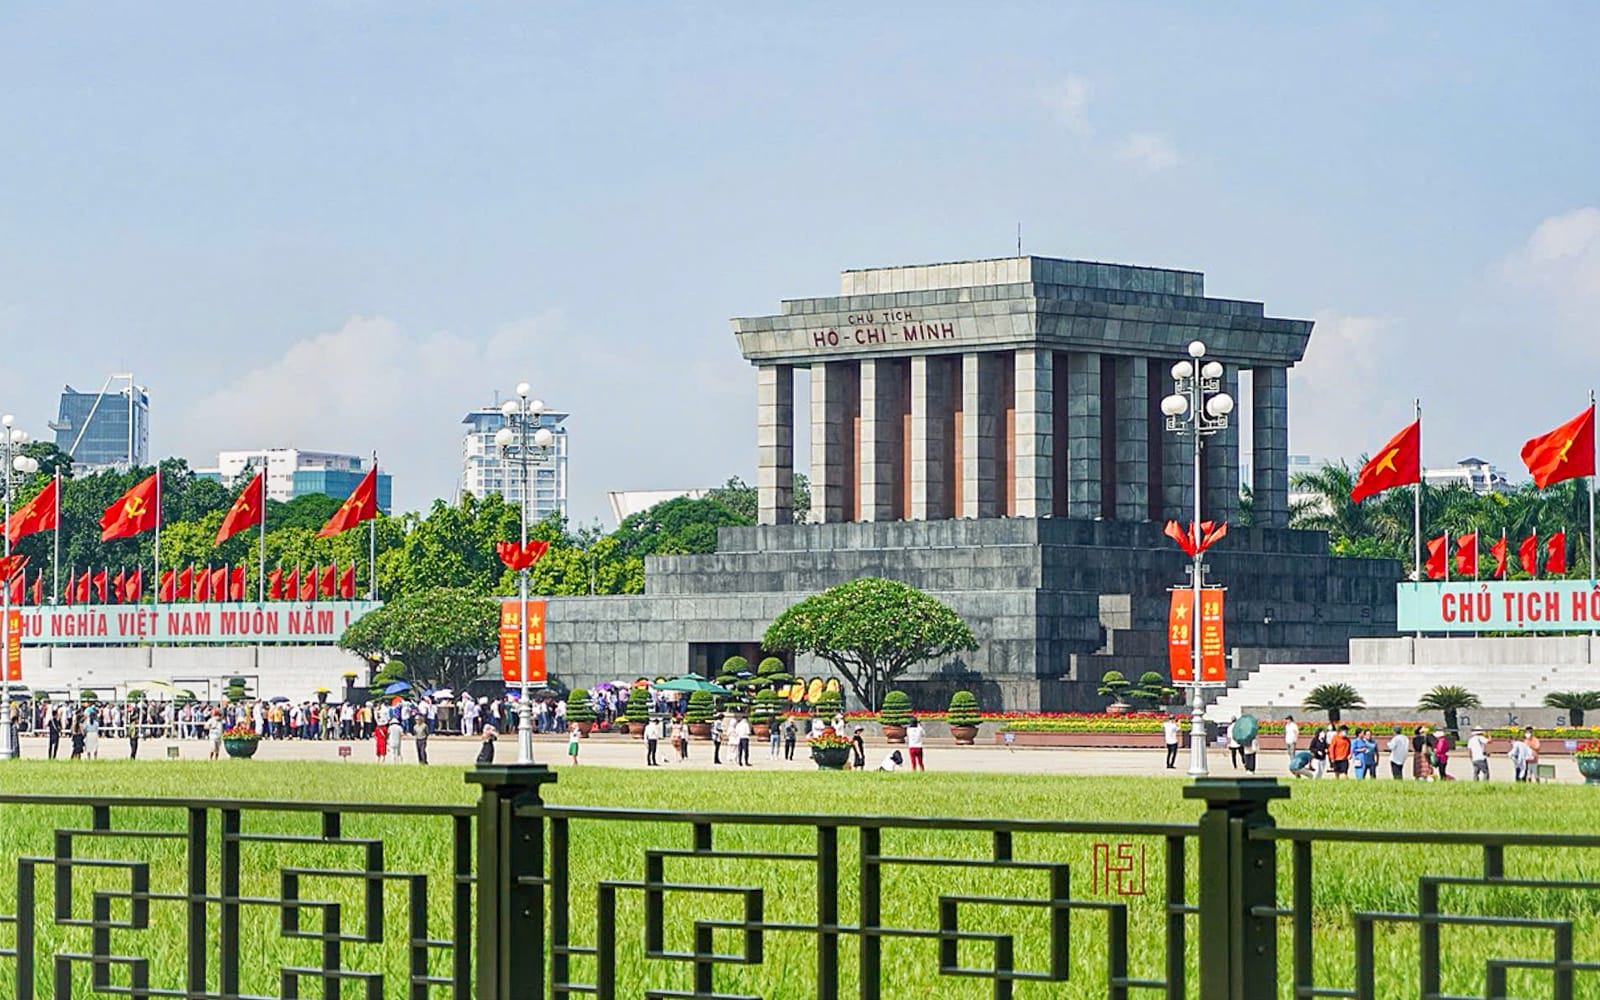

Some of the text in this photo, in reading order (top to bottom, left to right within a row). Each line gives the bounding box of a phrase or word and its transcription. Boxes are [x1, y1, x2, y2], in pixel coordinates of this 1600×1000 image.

[20, 608, 42, 636] HỦ
[51, 609, 108, 636] NGHĨA
[118, 608, 159, 640] VIỆT
[168, 612, 210, 635] NAM
[220, 606, 278, 635] MUÔN
[288, 605, 334, 635] NĂM
[1442, 583, 1491, 622] CHỦ
[1502, 591, 1559, 628] TỊCH
